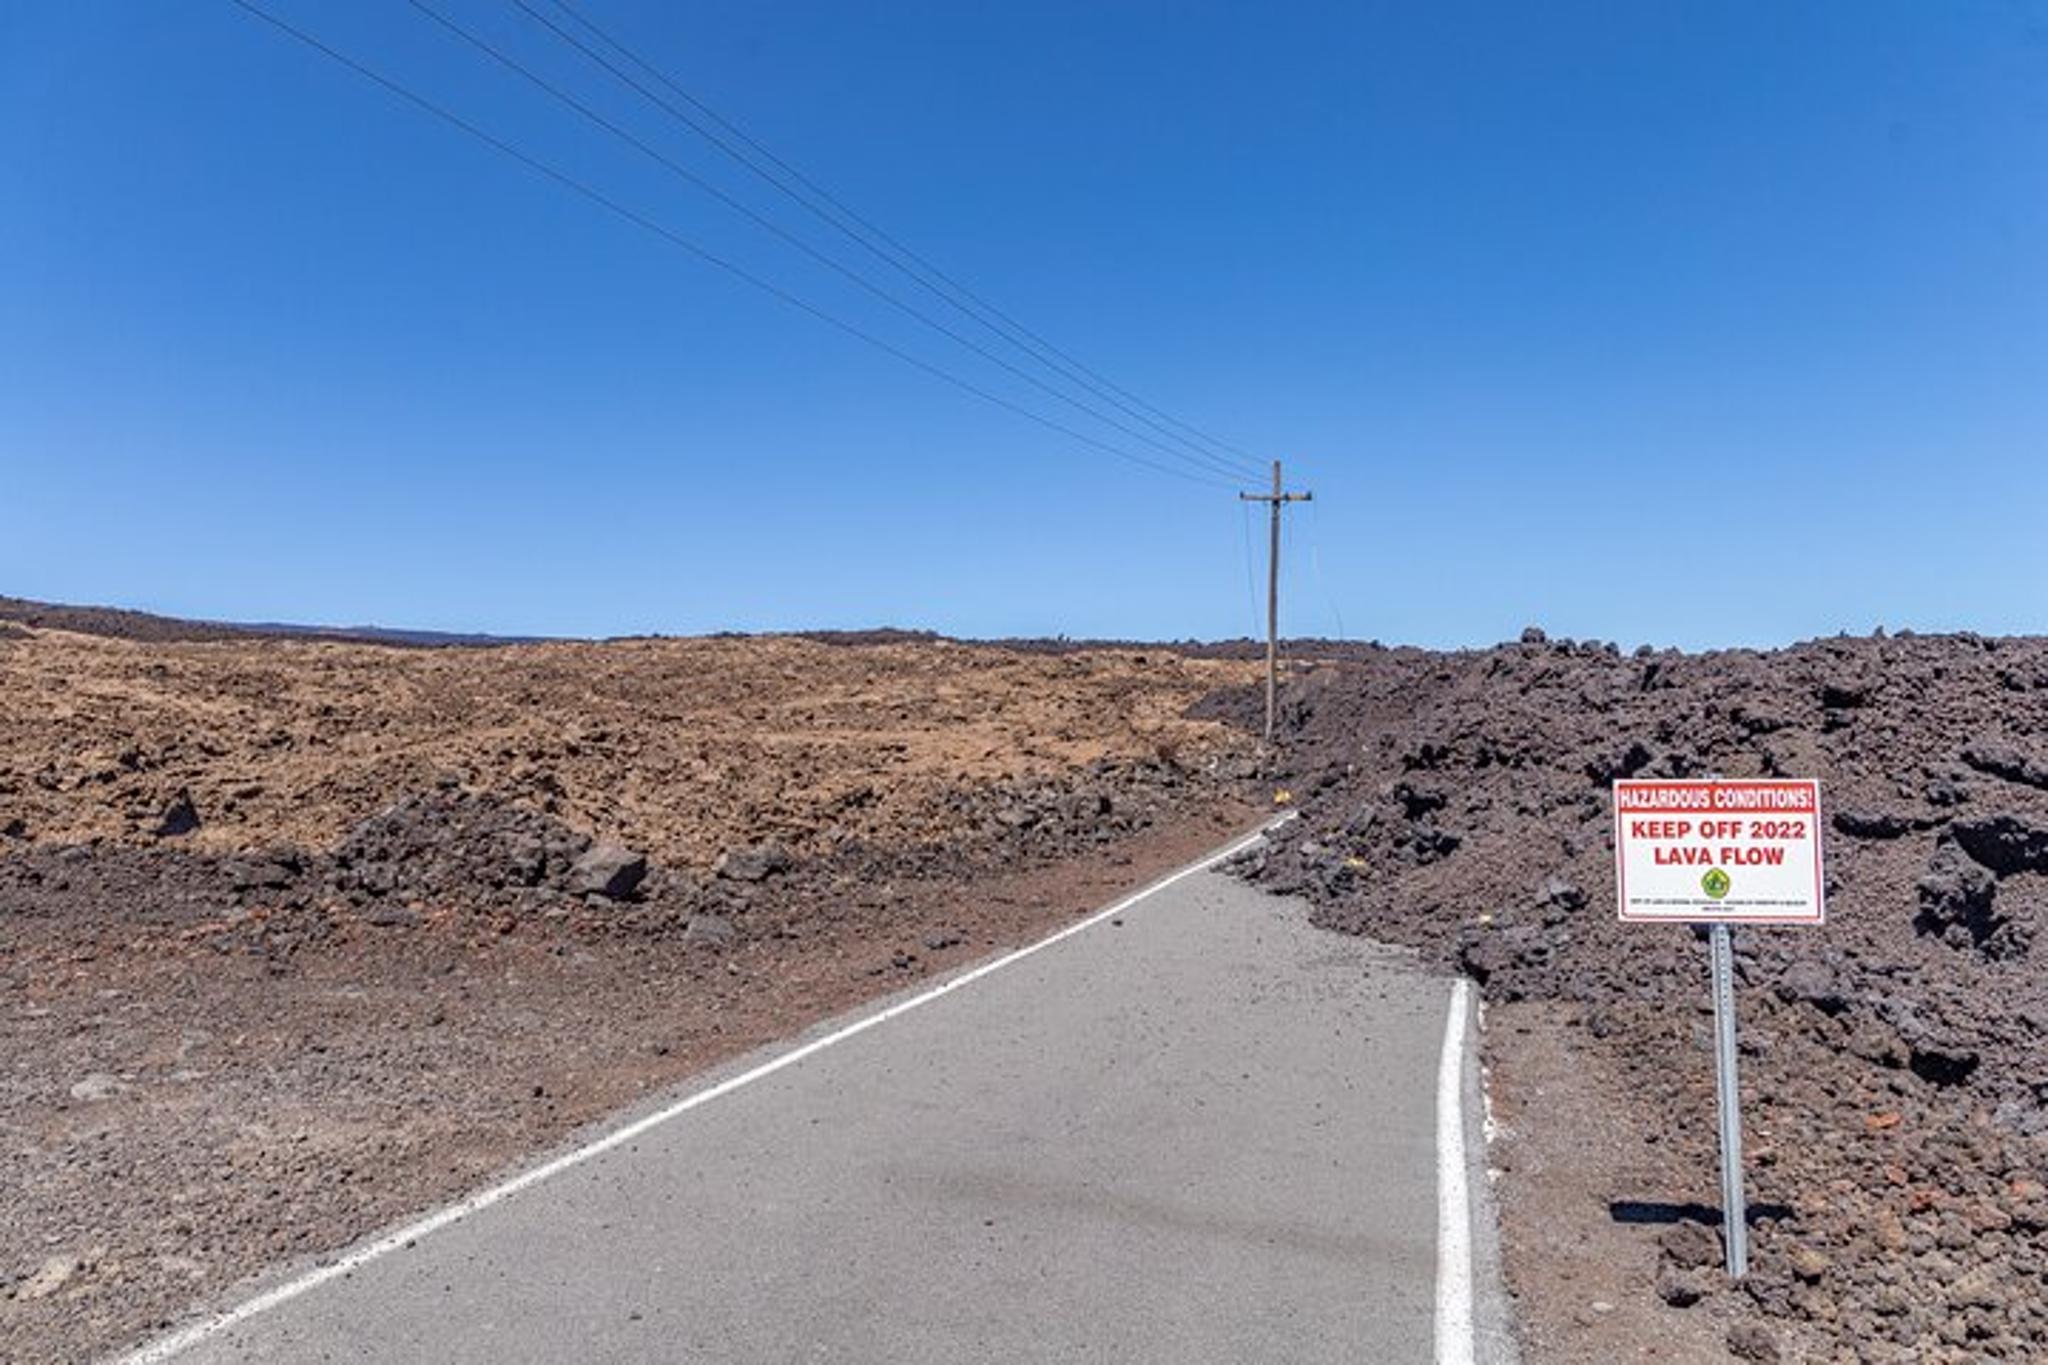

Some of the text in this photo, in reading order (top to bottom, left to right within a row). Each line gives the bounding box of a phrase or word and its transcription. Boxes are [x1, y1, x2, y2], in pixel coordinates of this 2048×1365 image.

[1620, 788, 1813, 808] HAZARDOUS CONDITIONS!
[1631, 821, 1806, 839] KEEP OFF 2022
[1654, 847, 1785, 865] LAVA FLOW
